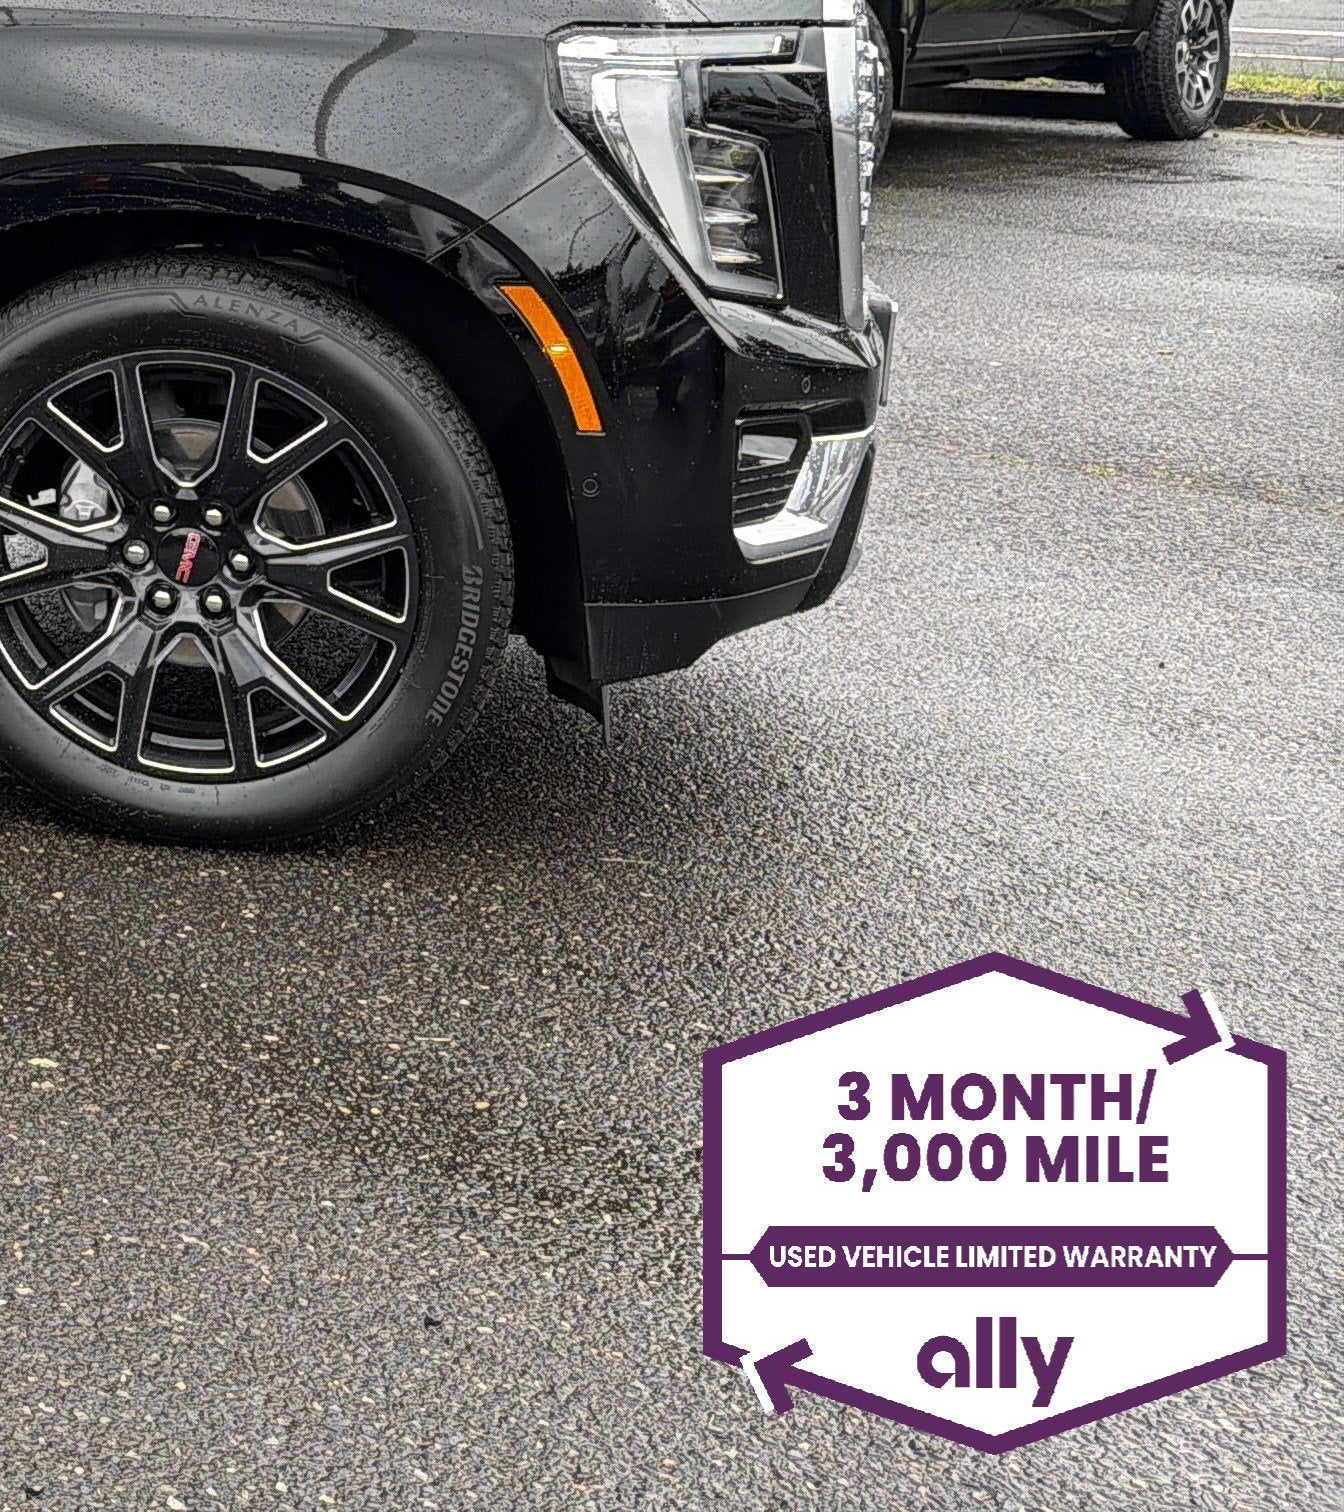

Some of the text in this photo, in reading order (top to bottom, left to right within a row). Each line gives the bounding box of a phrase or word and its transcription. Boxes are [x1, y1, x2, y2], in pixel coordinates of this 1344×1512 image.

[193, 294, 299, 333] ALENZA
[175, 532, 201, 584] GMC
[424, 565, 483, 727] BRIDGESTONE
